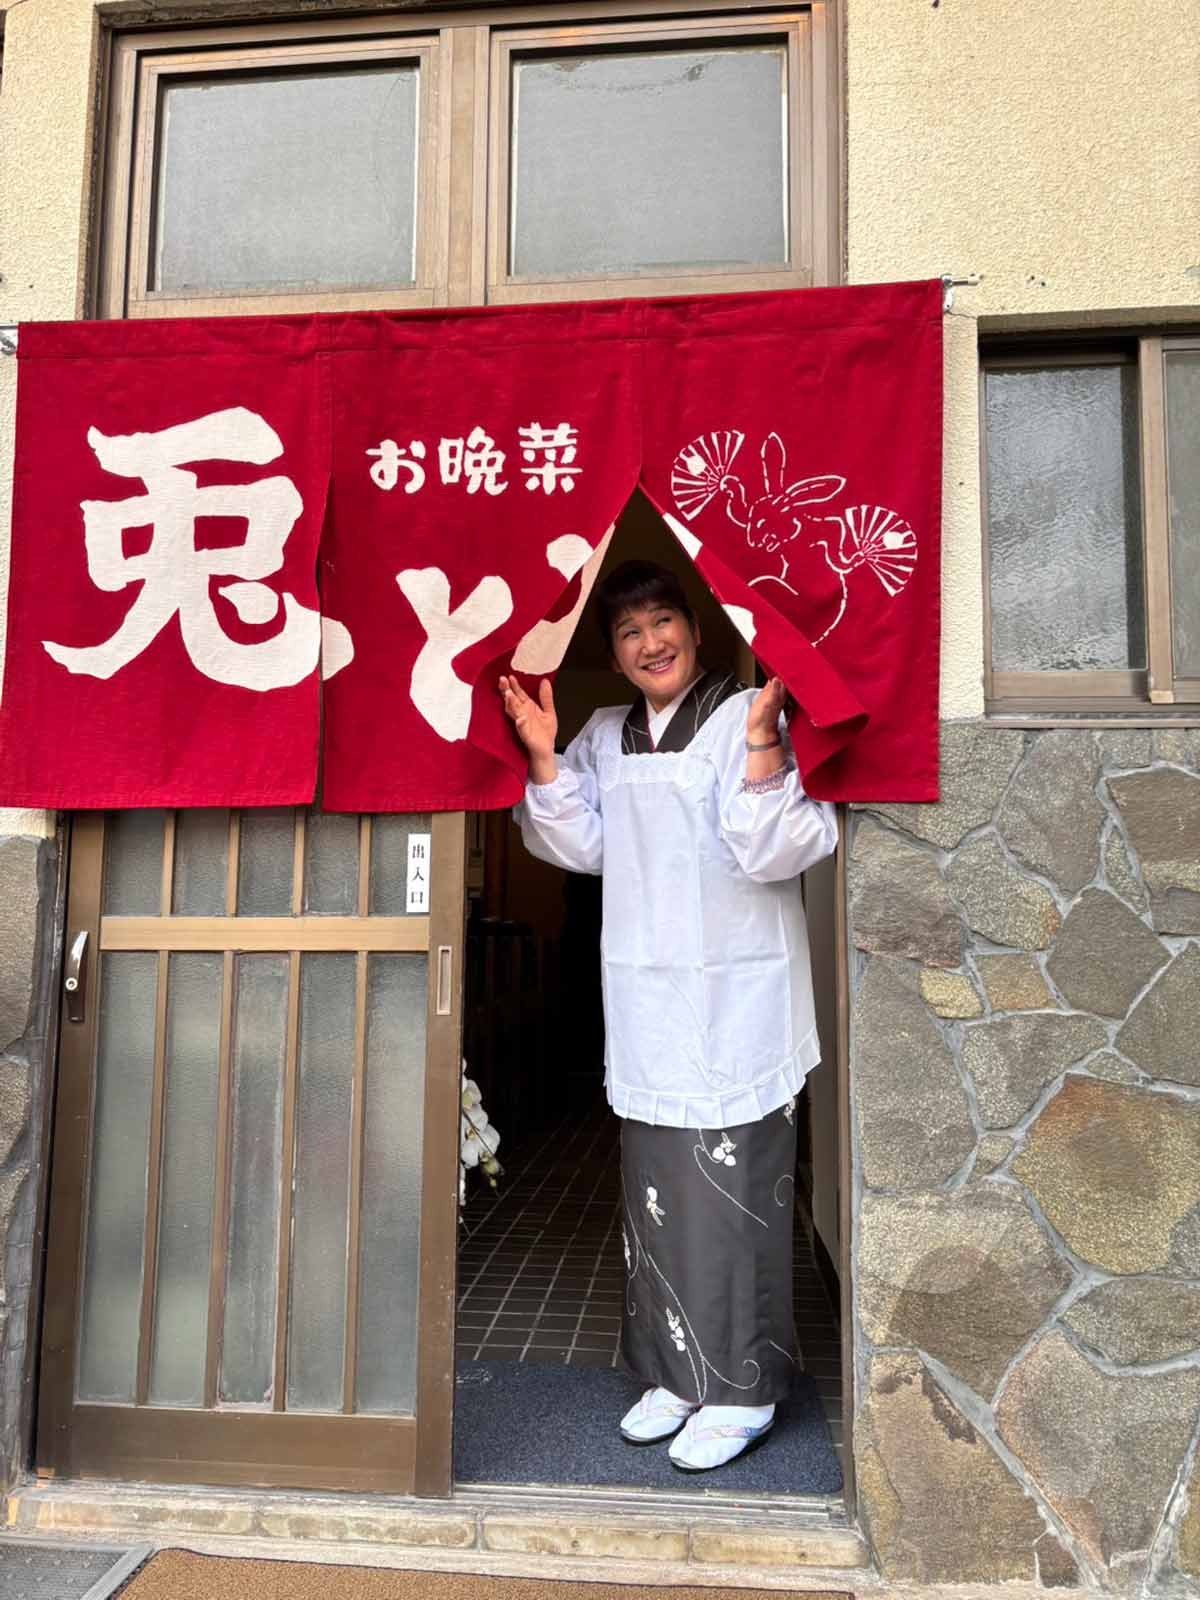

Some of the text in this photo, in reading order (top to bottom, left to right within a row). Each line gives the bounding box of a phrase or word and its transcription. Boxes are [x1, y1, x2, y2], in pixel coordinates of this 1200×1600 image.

[365, 421, 584, 496] お晩菜
[410, 843, 426, 905] 出入口
